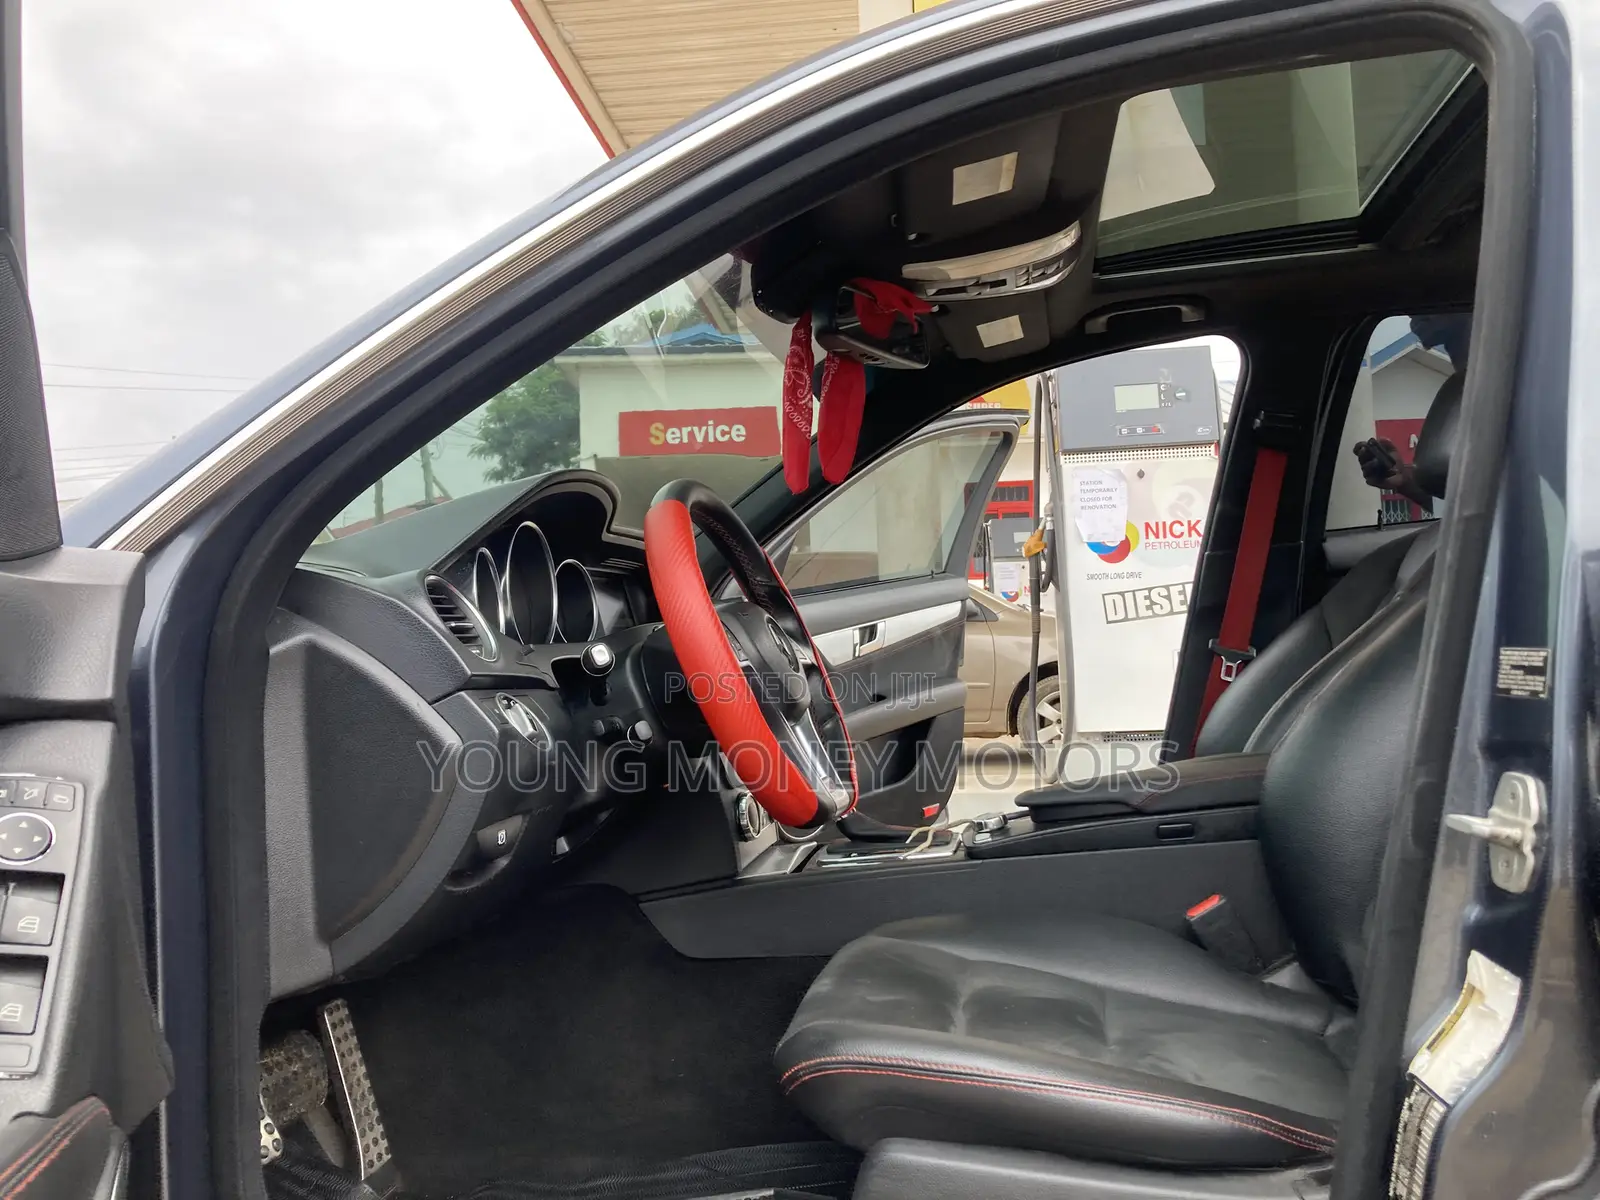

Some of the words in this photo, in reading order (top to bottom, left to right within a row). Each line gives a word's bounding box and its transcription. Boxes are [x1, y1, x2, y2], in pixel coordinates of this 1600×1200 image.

[649, 420, 746, 446] Service
[1144, 519, 1204, 540] NICK
[1086, 572, 1110, 581] SMOOTH
[1109, 571, 1126, 580] LONG
[1126, 571, 1143, 579] DRIVE
